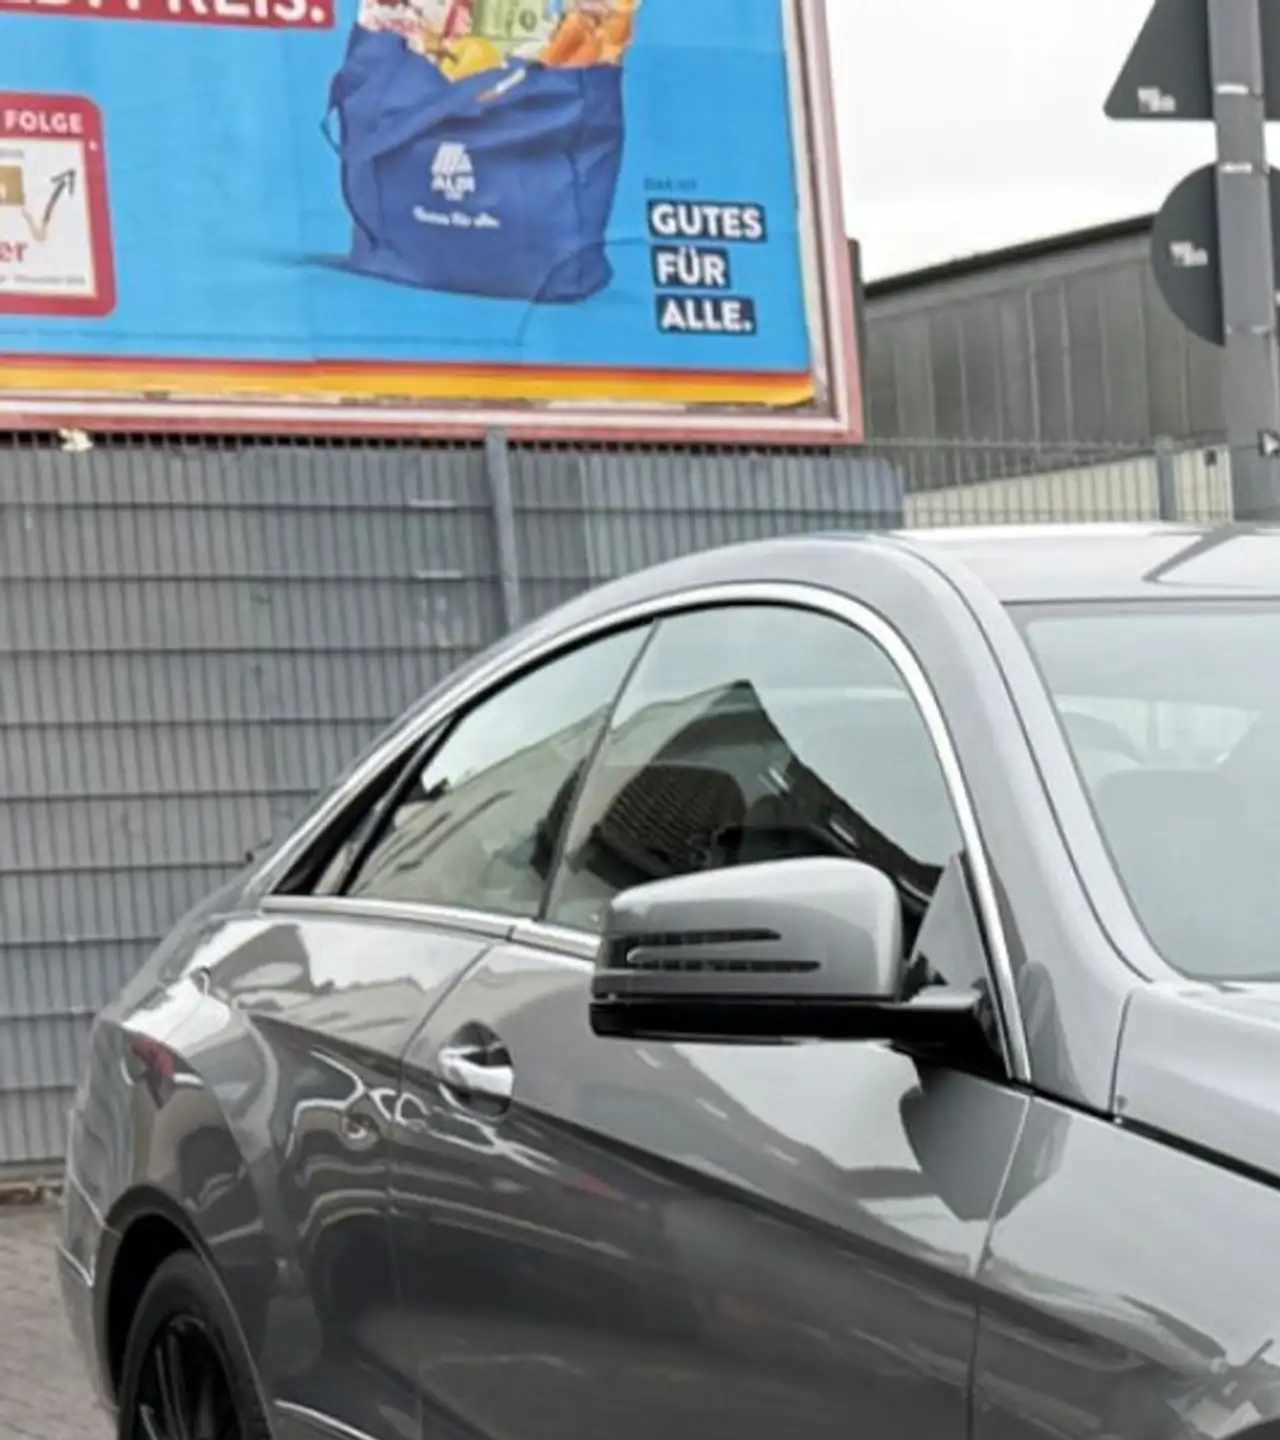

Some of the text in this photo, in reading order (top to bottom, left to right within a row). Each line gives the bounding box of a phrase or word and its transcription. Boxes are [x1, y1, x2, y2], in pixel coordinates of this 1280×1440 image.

[4, 109, 84, 134] FOLGE
[652, 203, 762, 239] GUTES
[656, 247, 726, 286] FÜR
[661, 299, 752, 331] ALLE.
